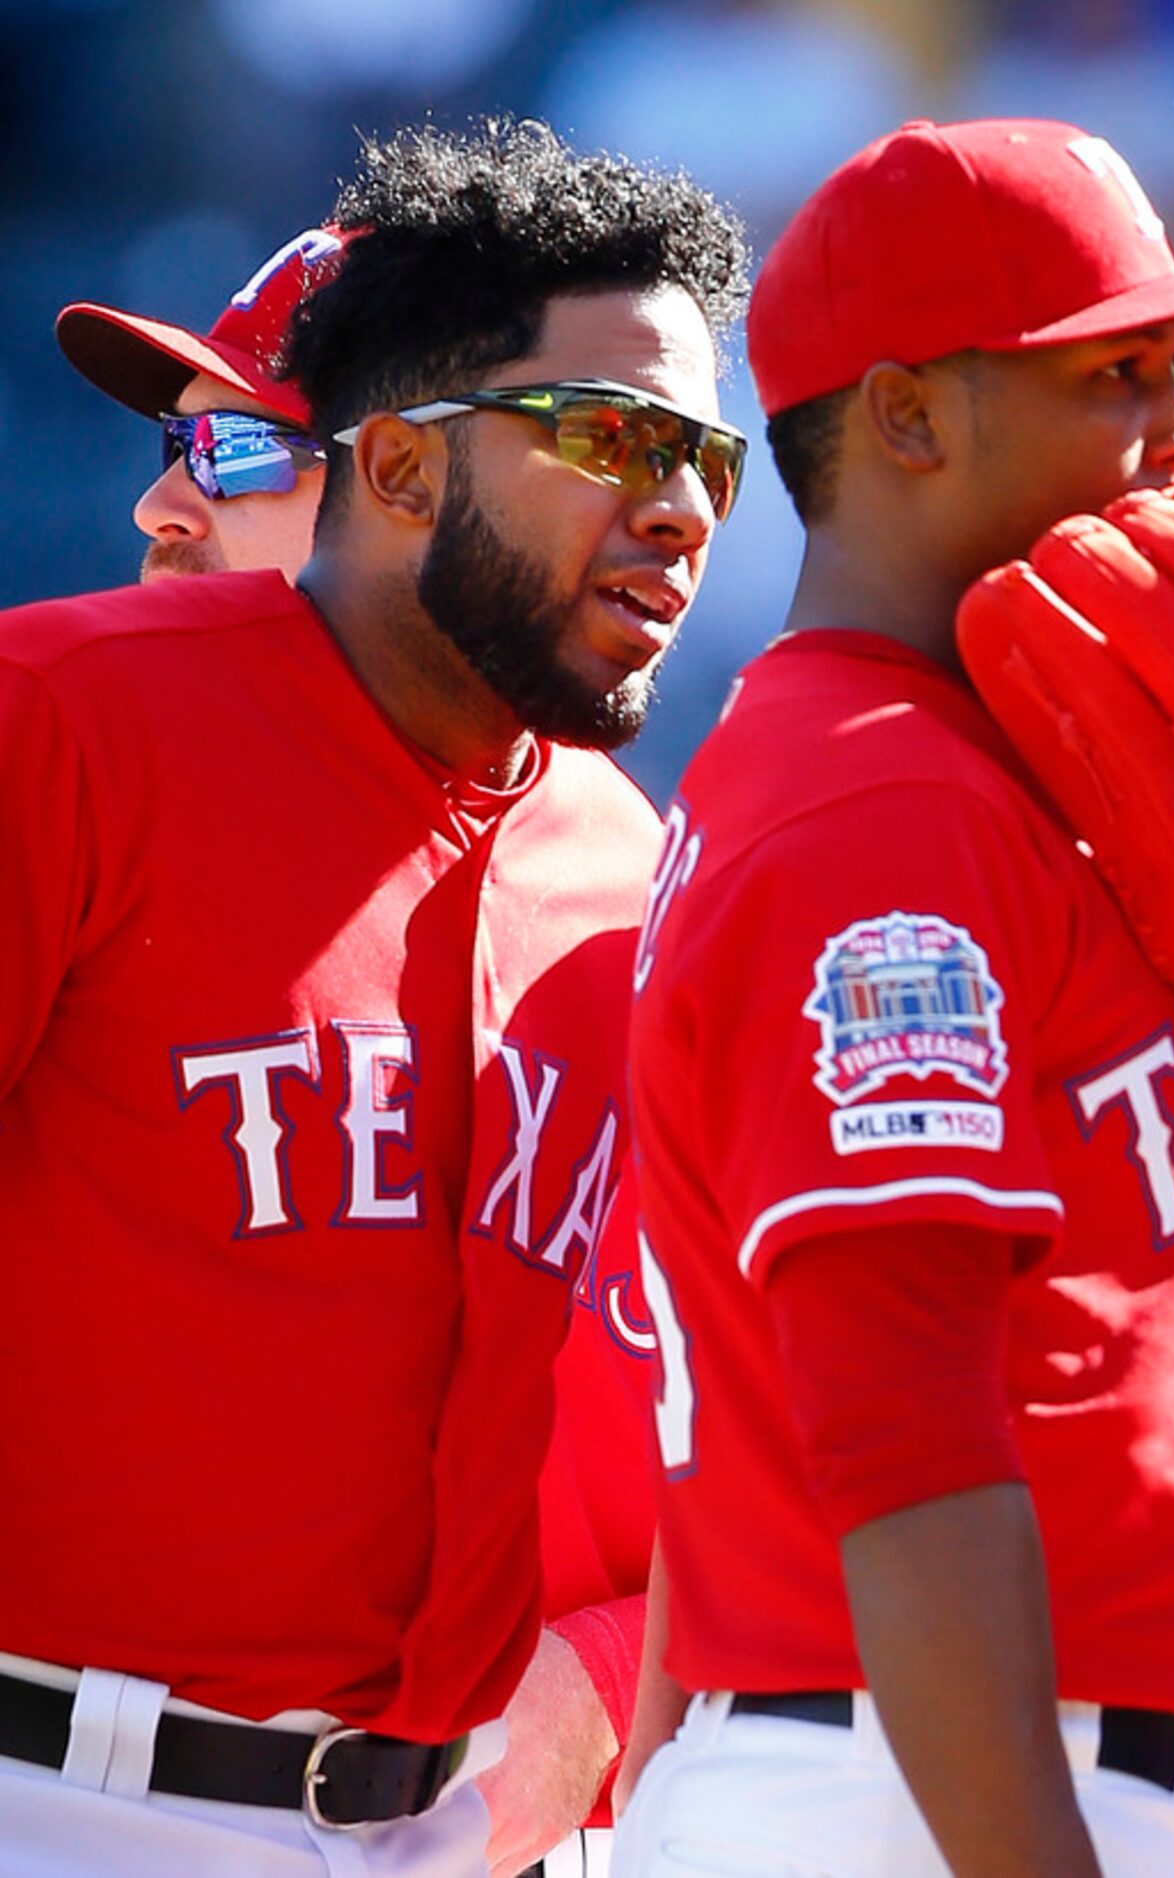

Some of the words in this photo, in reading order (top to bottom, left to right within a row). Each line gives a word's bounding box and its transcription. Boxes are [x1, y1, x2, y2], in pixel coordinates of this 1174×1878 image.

[838, 1034, 906, 1078] FINAL
[907, 1032, 990, 1069] SEASON
[842, 1112, 906, 1142] MLB
[168, 1017, 636, 1312] TEXA
